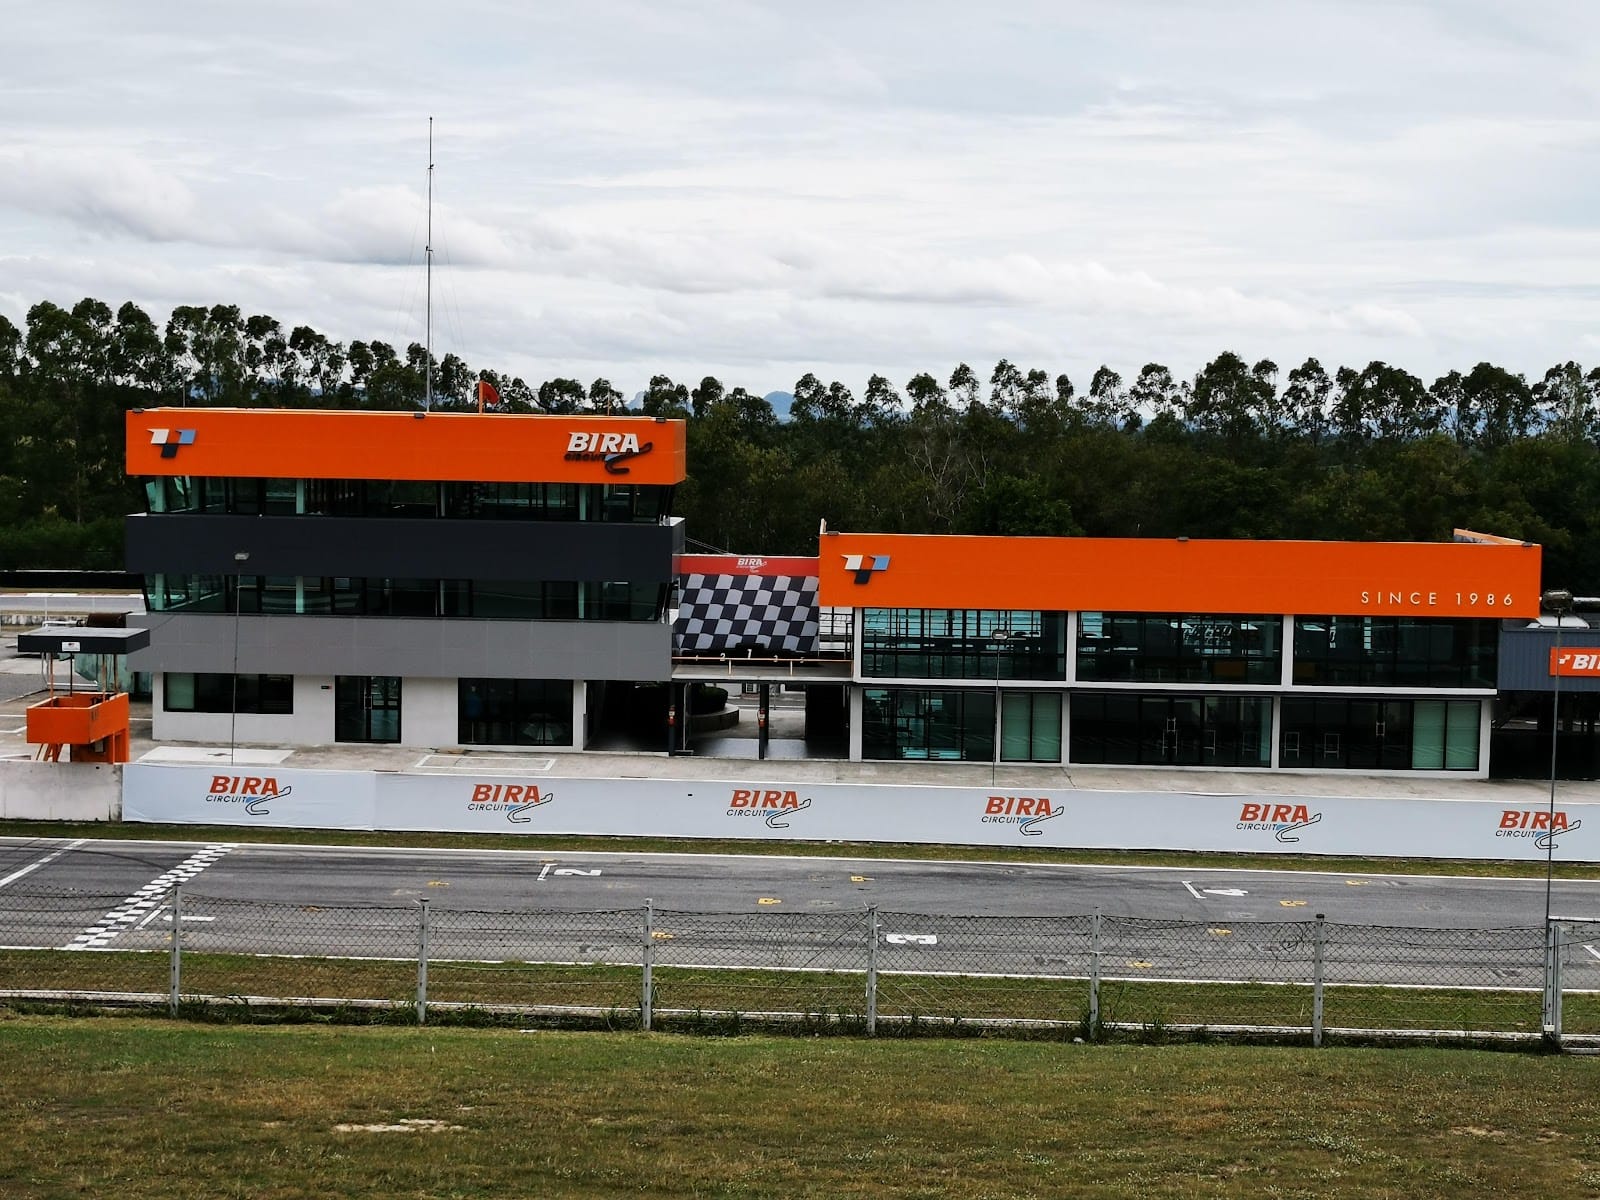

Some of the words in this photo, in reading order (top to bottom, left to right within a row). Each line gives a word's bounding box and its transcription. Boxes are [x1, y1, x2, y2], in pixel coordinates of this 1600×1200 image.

[567, 431, 640, 453] BIRA
[737, 558, 763, 566] BIRA
[1361, 591, 1437, 605] SINCE
[1456, 592, 1513, 606] 1986
[1572, 654, 1600, 670] BI
[209, 775, 279, 796] BIRA
[205, 794, 248, 804] CIRCUIT
[471, 783, 541, 804] BIRA
[730, 789, 799, 809] BIRA
[467, 803, 509, 812] CIRCUIT
[726, 809, 768, 817] CIRCUIT
[985, 796, 1052, 816] BIRA
[1240, 803, 1309, 823] BIRA
[981, 815, 1021, 824] CIRCUIT
[1236, 822, 1278, 831] CIRCUIT
[1499, 810, 1568, 830] BIRA
[1495, 830, 1537, 838] CIRCUIT
